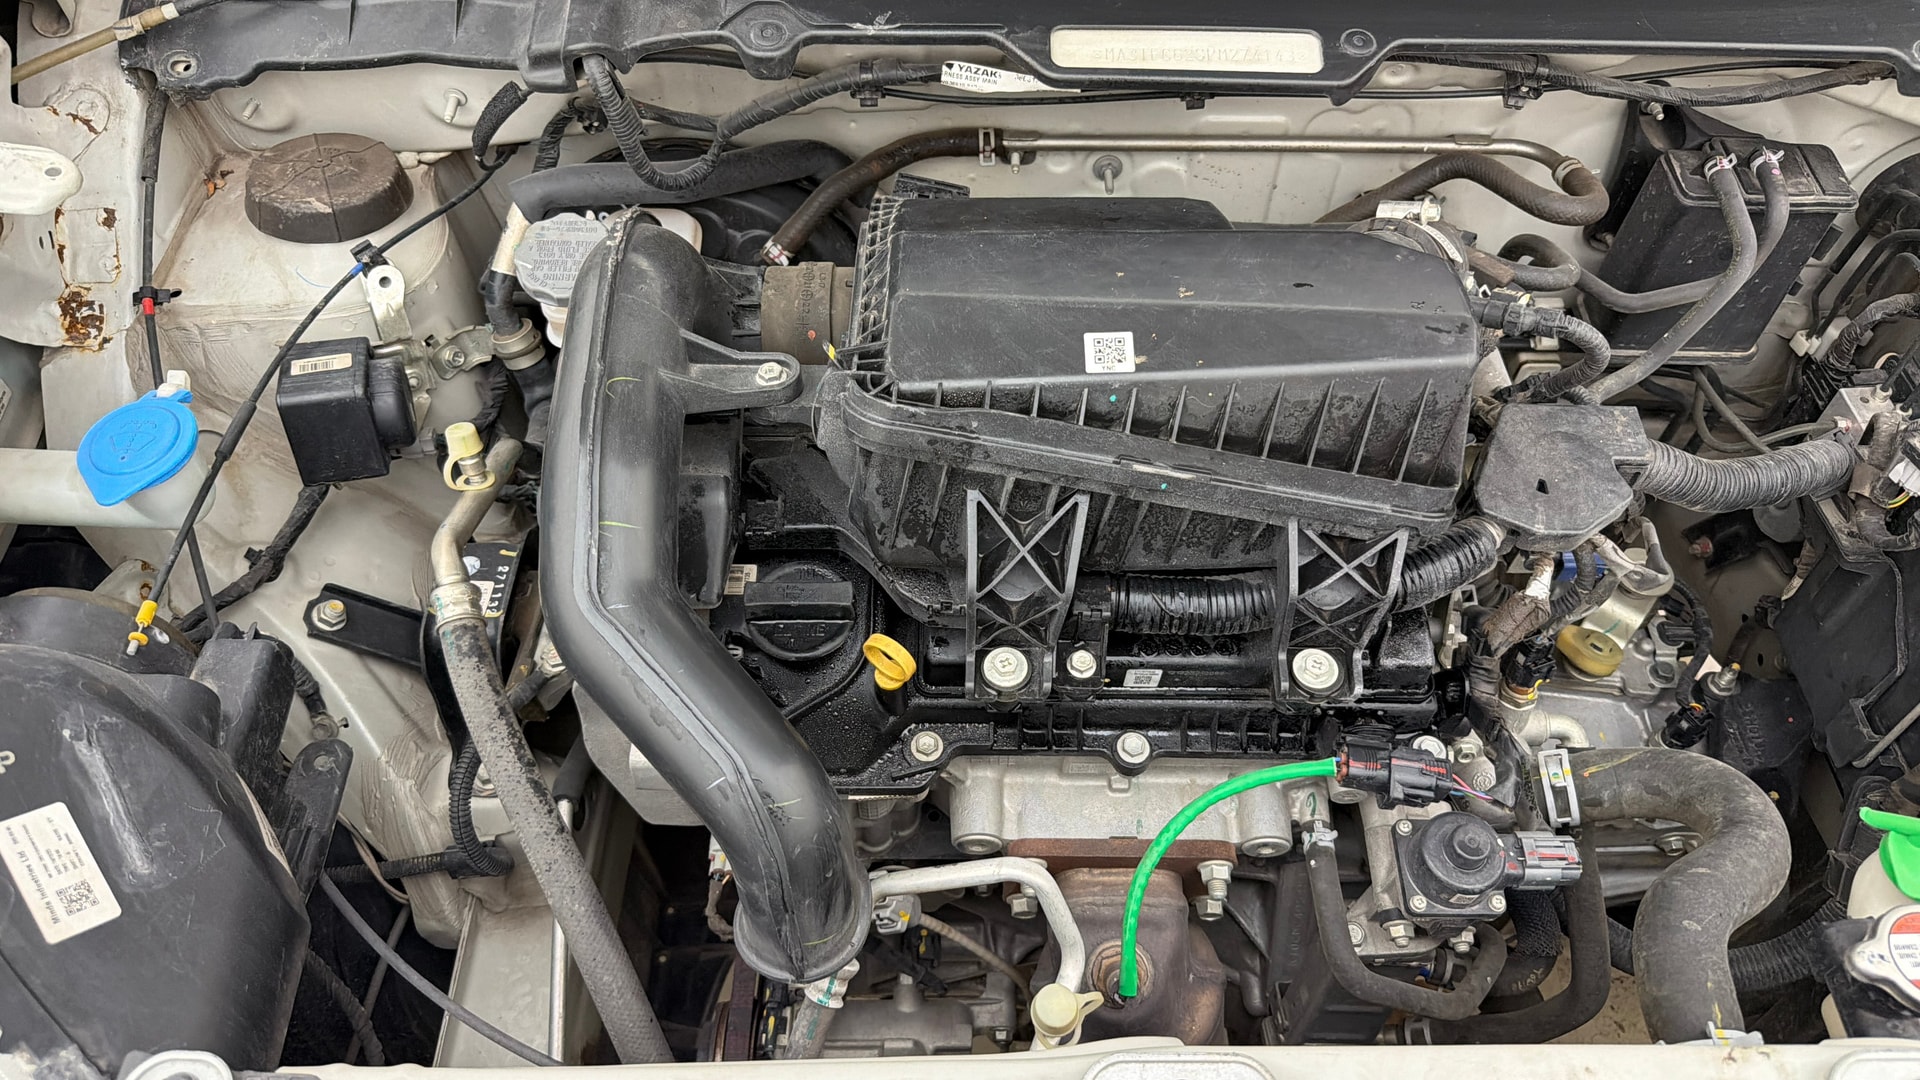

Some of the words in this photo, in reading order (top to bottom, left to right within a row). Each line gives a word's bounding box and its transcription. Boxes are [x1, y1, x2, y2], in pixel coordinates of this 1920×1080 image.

[965, 75, 980, 83] ASSY
[981, 77, 998, 85] MAIN
[542, 273, 577, 282] ARNING
[16, 850, 29, 863] Ltd
[25, 863, 48, 902] Industries
[44, 901, 61, 924] Minda
